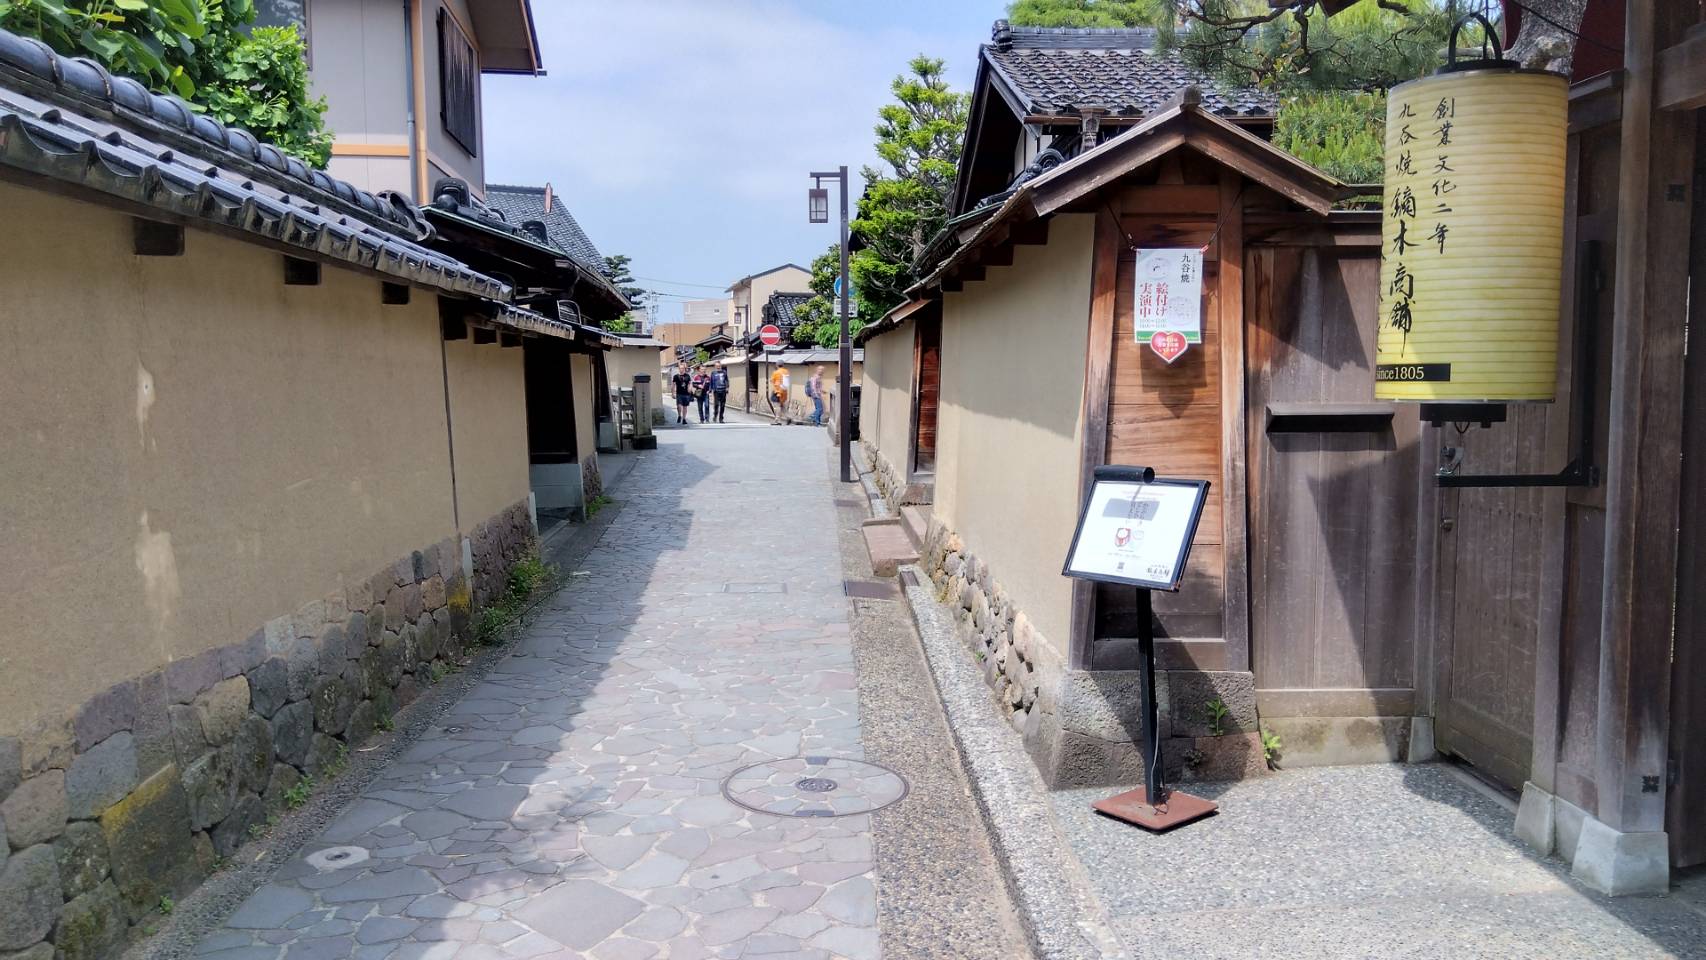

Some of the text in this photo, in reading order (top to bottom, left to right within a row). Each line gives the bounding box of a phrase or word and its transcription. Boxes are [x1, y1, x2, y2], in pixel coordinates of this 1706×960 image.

[1427, 97, 1457, 254] 創業文化二年
[1181, 252, 1191, 283] 九谷焼
[1139, 282, 1152, 318] 実演中
[1155, 282, 1168, 317] 絵付け
